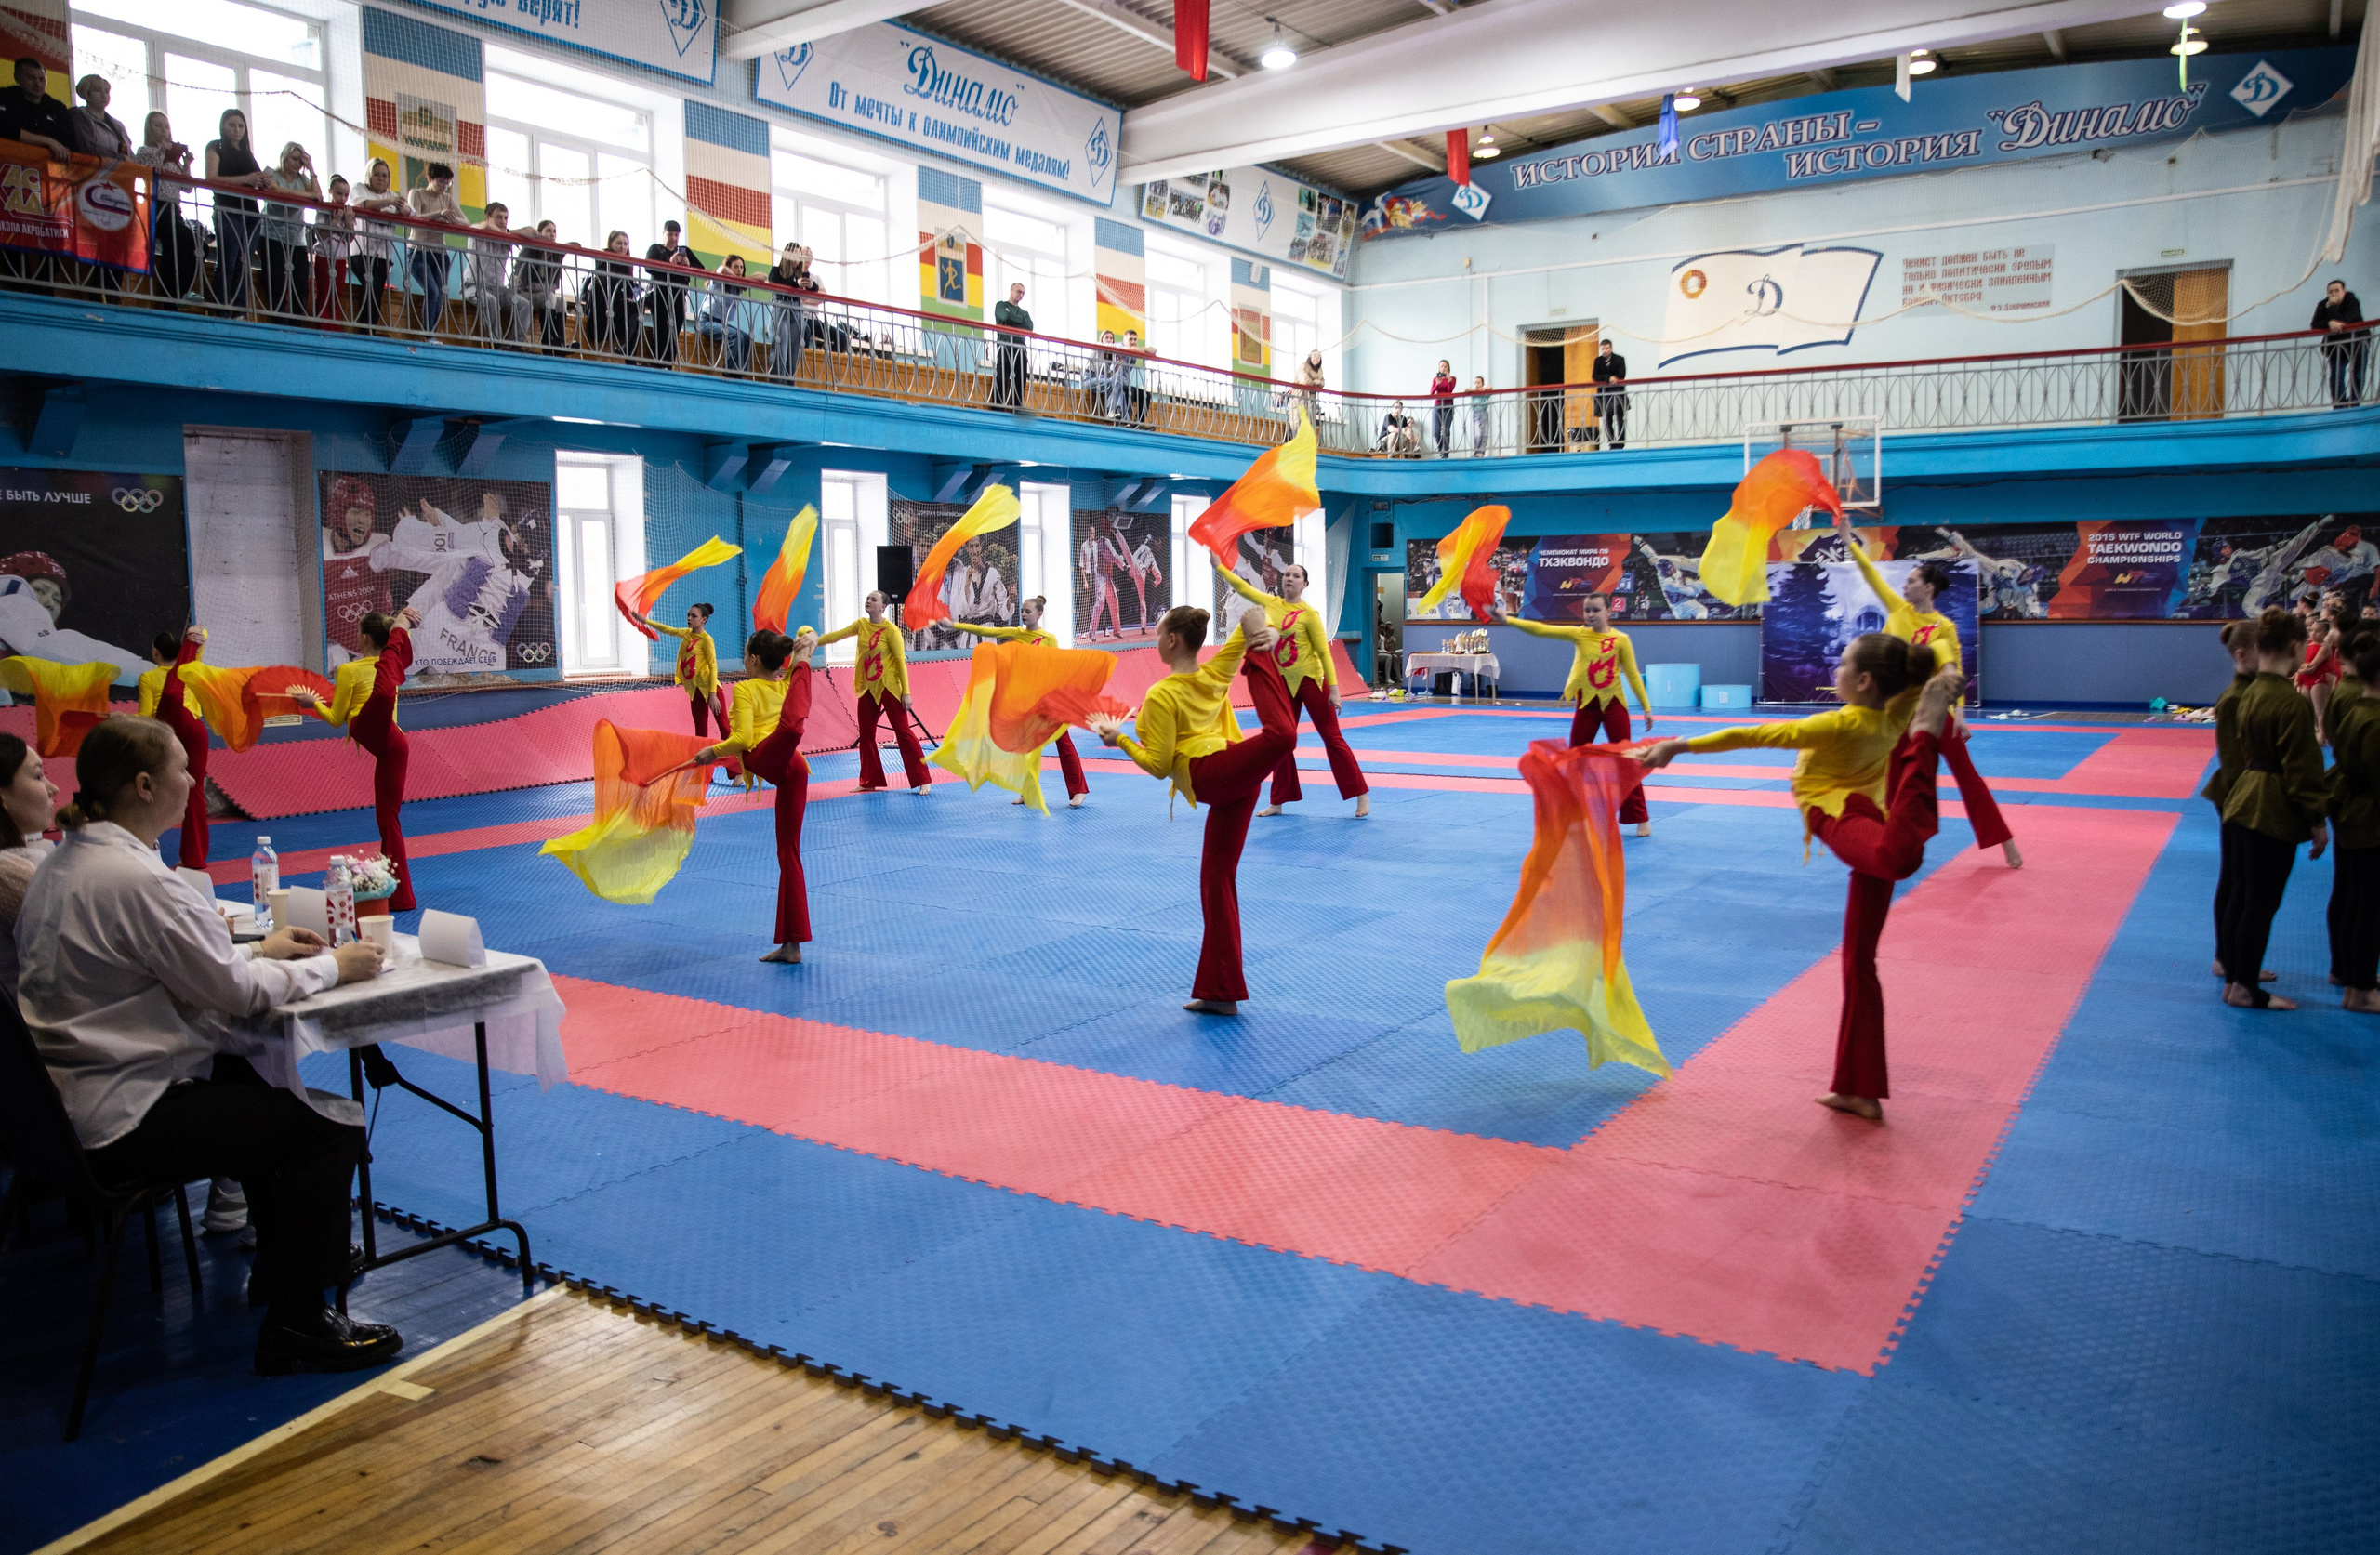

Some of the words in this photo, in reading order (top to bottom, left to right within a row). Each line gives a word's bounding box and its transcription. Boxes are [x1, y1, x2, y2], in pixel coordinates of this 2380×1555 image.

[1512, 139, 1682, 190] ИСТОРИЯ
[1686, 112, 1852, 162] СТРАНЫ
[1786, 128, 1983, 180] ИСТОРИЯ
[0, 220, 20, 233] КОЛА
[6, 490, 41, 503] БЫТЬ
[44, 492, 92, 505] ЛУЧШЕ
[2088, 533, 2116, 542] 2015
[2118, 532, 2141, 541] WTF
[2143, 531, 2183, 540] WORLD
[2087, 541, 2182, 554] TAEKWONDO
[1539, 556, 1610, 569] ТХЭКВОНДО
[2087, 554, 2181, 564] CHAMPIONSHIPS
[328, 588, 358, 600] ATHENS
[439, 626, 496, 667] FRANCE
[431, 657, 477, 665] ПОБЕЖДАЕТ
[478, 655, 496, 664] СЕБЯ
